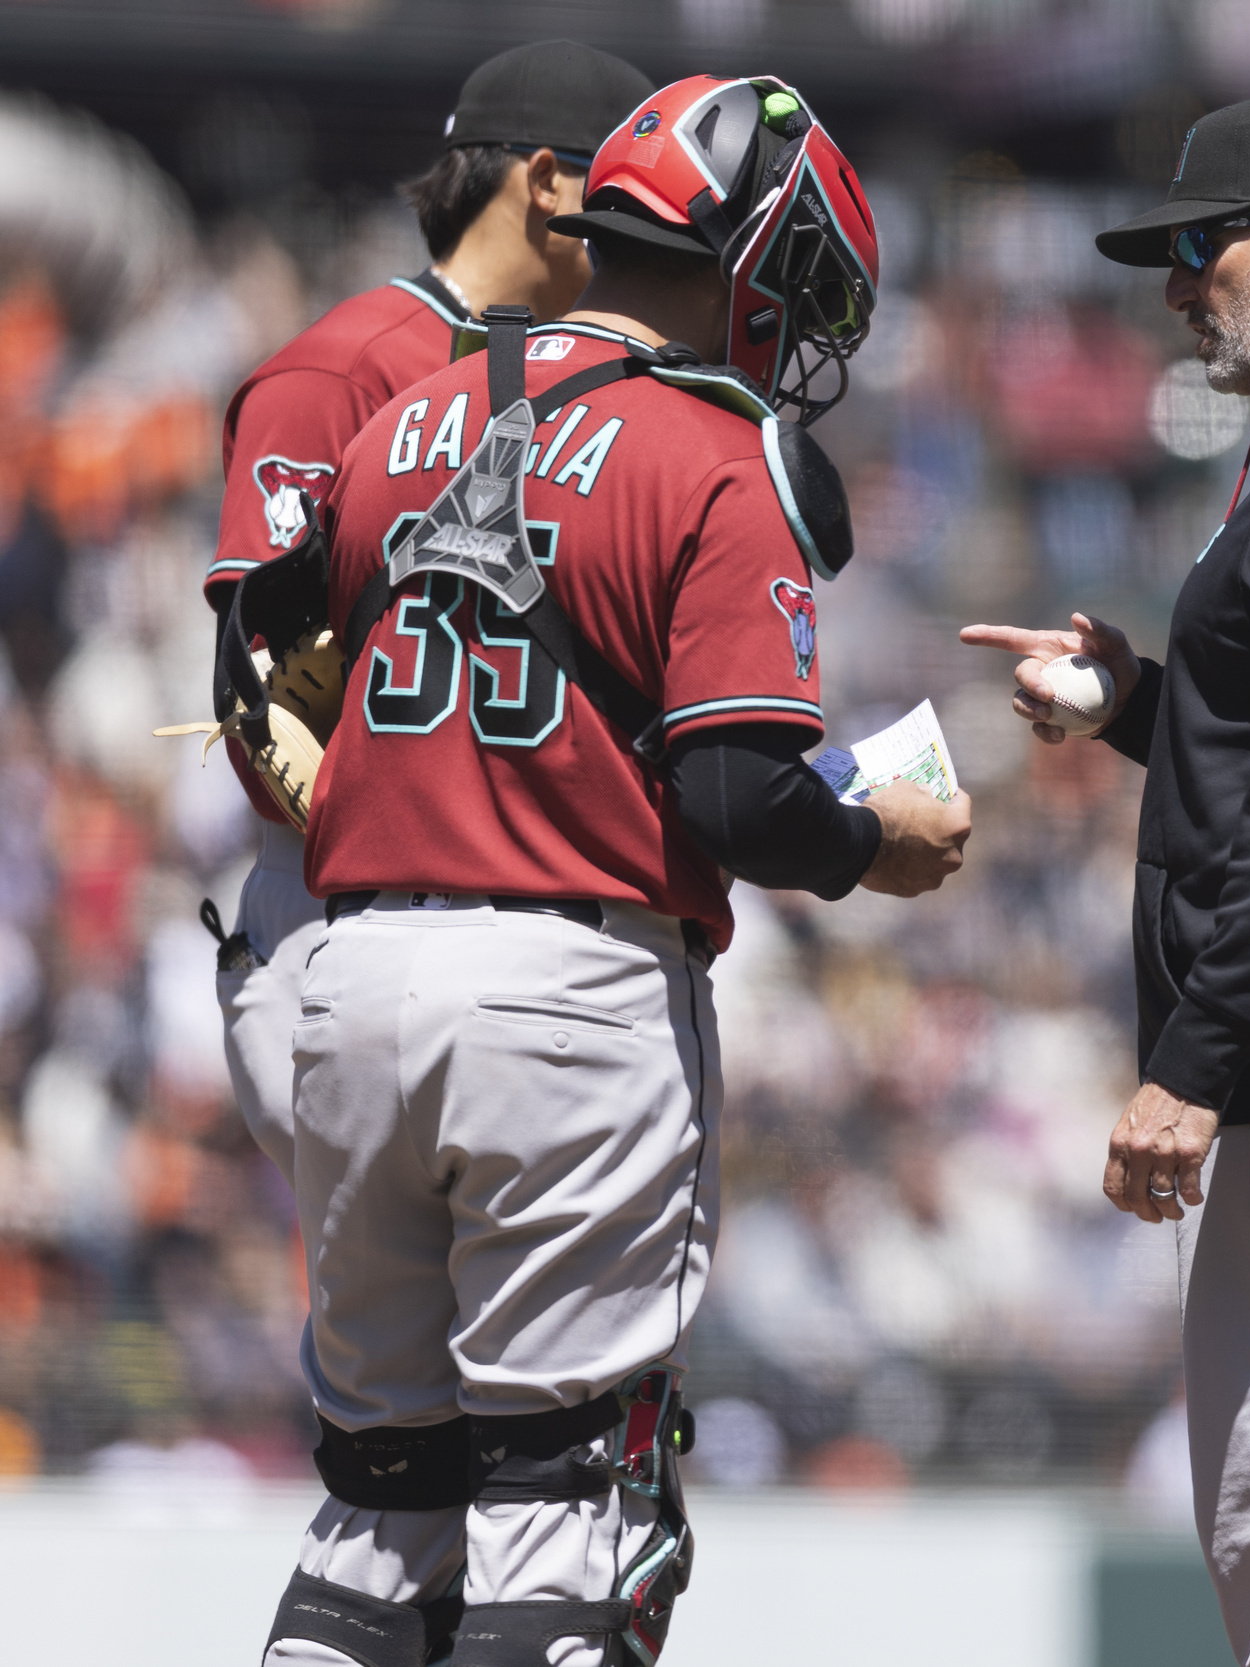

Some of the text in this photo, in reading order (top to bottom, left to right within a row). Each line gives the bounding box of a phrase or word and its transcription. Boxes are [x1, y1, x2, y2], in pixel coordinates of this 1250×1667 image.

[387, 392, 624, 497] GAIA
[421, 525, 512, 565] ALL-STAR
[363, 511, 566, 747] 35
[293, 1603, 342, 1619] DELTA
